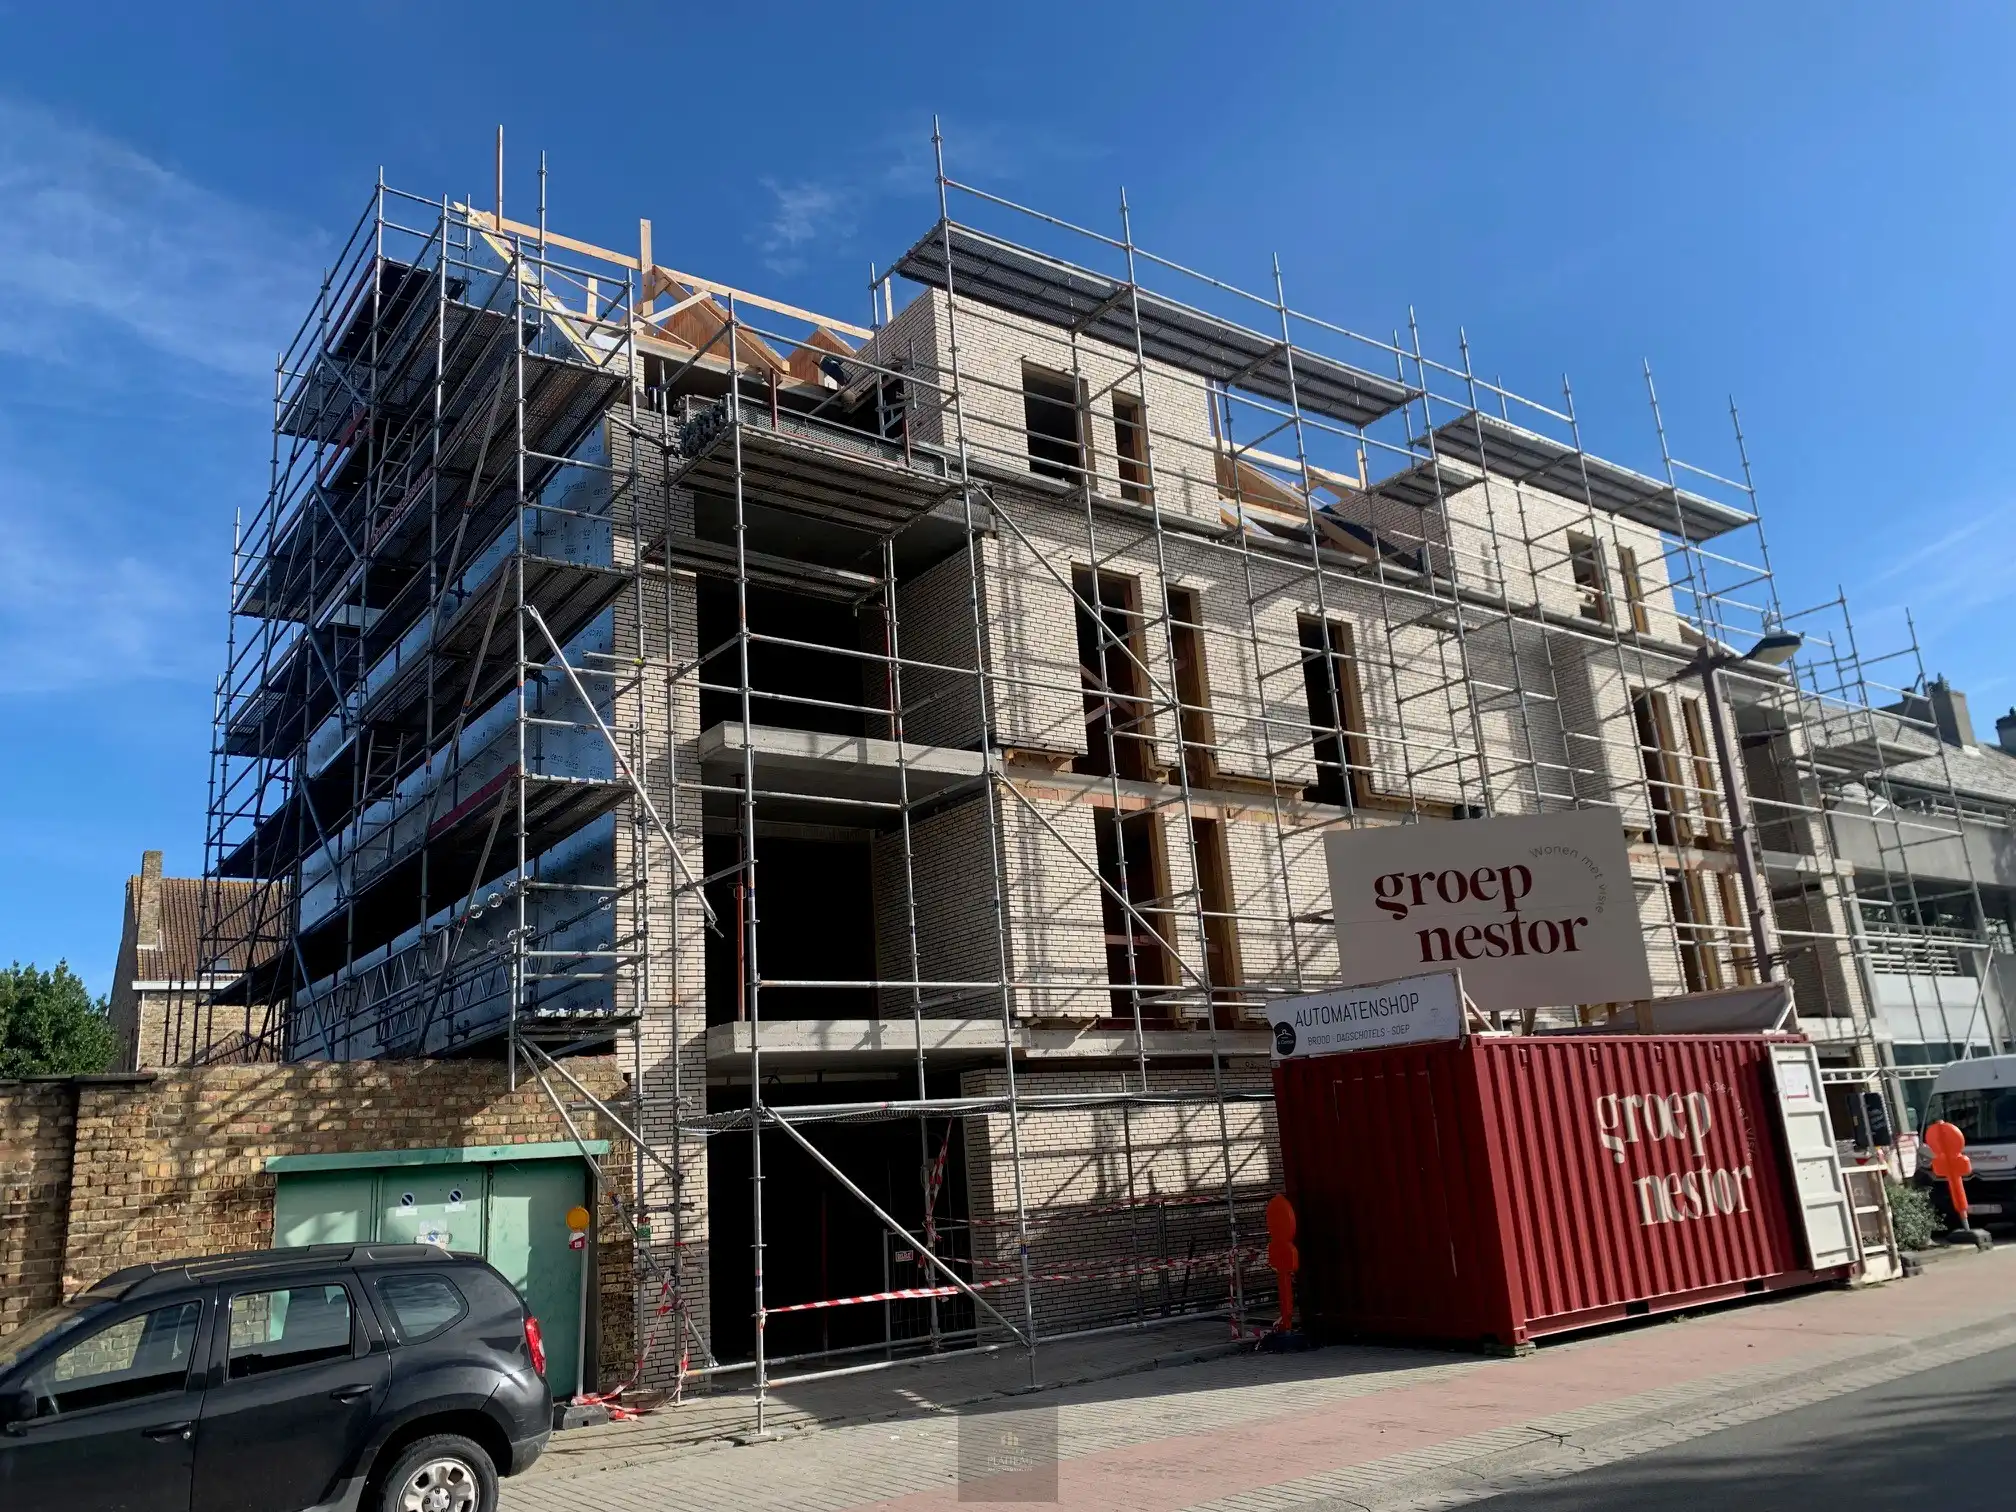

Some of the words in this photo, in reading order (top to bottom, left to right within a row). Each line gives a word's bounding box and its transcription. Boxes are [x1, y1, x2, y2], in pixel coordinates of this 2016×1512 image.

[1529, 845, 1579, 858] Wonen
[1581, 856, 1603, 880] met
[1374, 864, 1533, 921] groep
[1415, 911, 1588, 963] nestor
[1294, 992, 1420, 1028] AUTOMATENSHOP
[1336, 1027, 1386, 1043] DAGSCHOTELS
[1391, 1023, 1411, 1036] SOEP
[1596, 1091, 1712, 1164] groep
[1632, 1162, 1753, 1226] nestor
